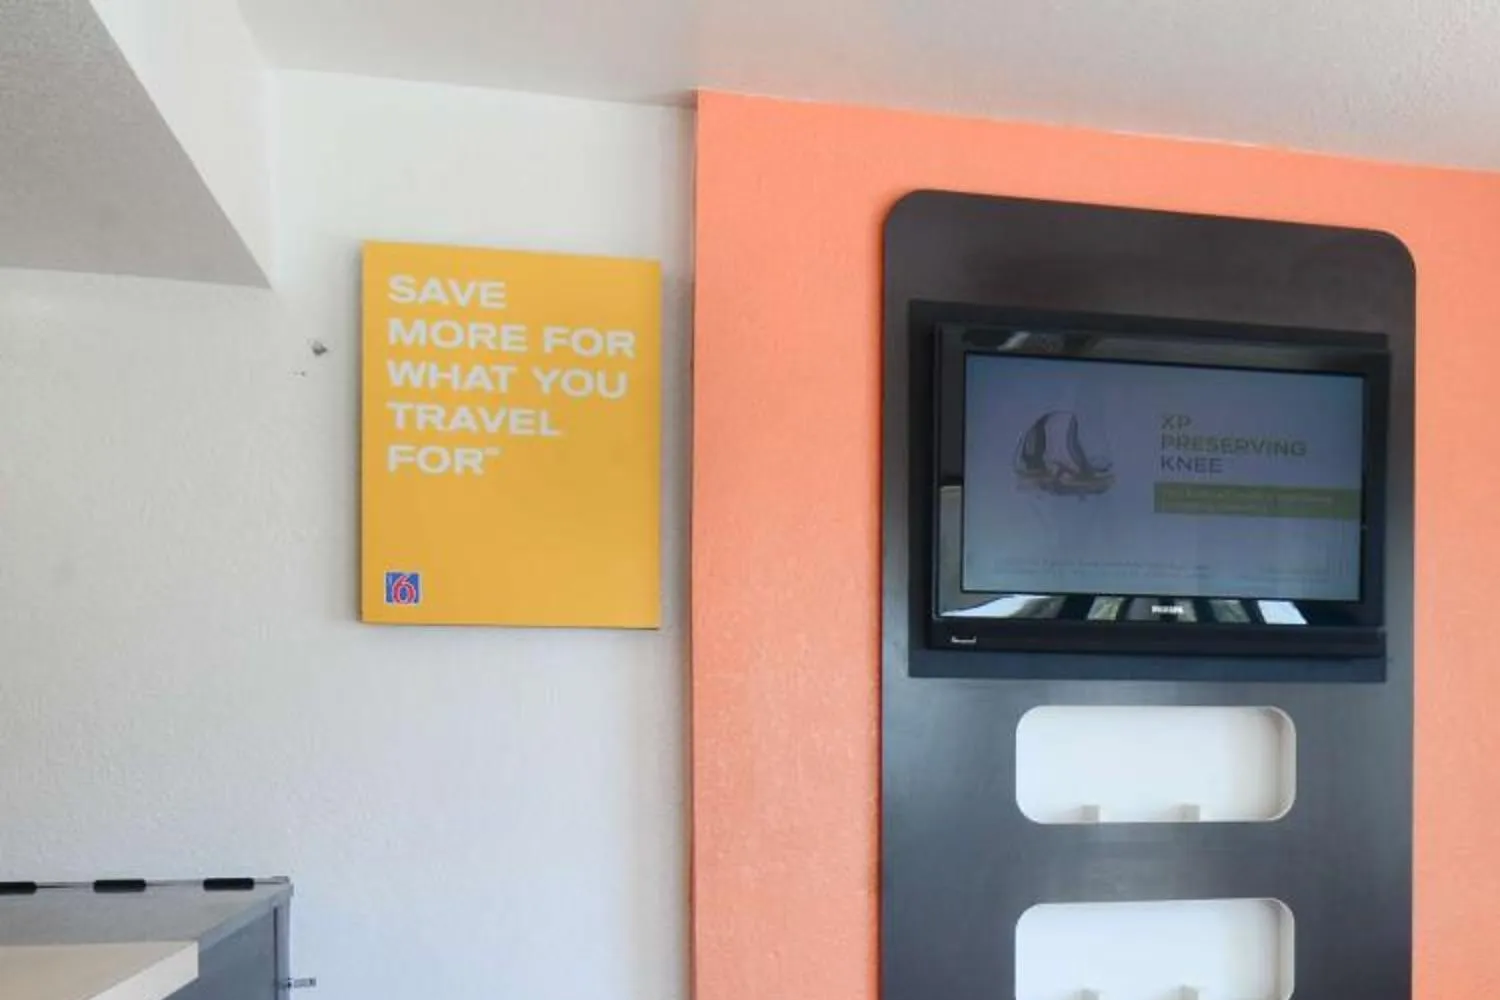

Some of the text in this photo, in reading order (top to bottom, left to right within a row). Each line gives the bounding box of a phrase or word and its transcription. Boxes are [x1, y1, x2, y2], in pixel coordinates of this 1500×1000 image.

[388, 273, 507, 310] SAVE
[387, 317, 637, 359] MORE FOR
[386, 360, 628, 400] WHAT YOU
[386, 401, 563, 438] TRAVEL
[1160, 432, 1307, 457] PRESERVING
[1160, 455, 1225, 474] KNEE
[392, 575, 417, 604] 6
